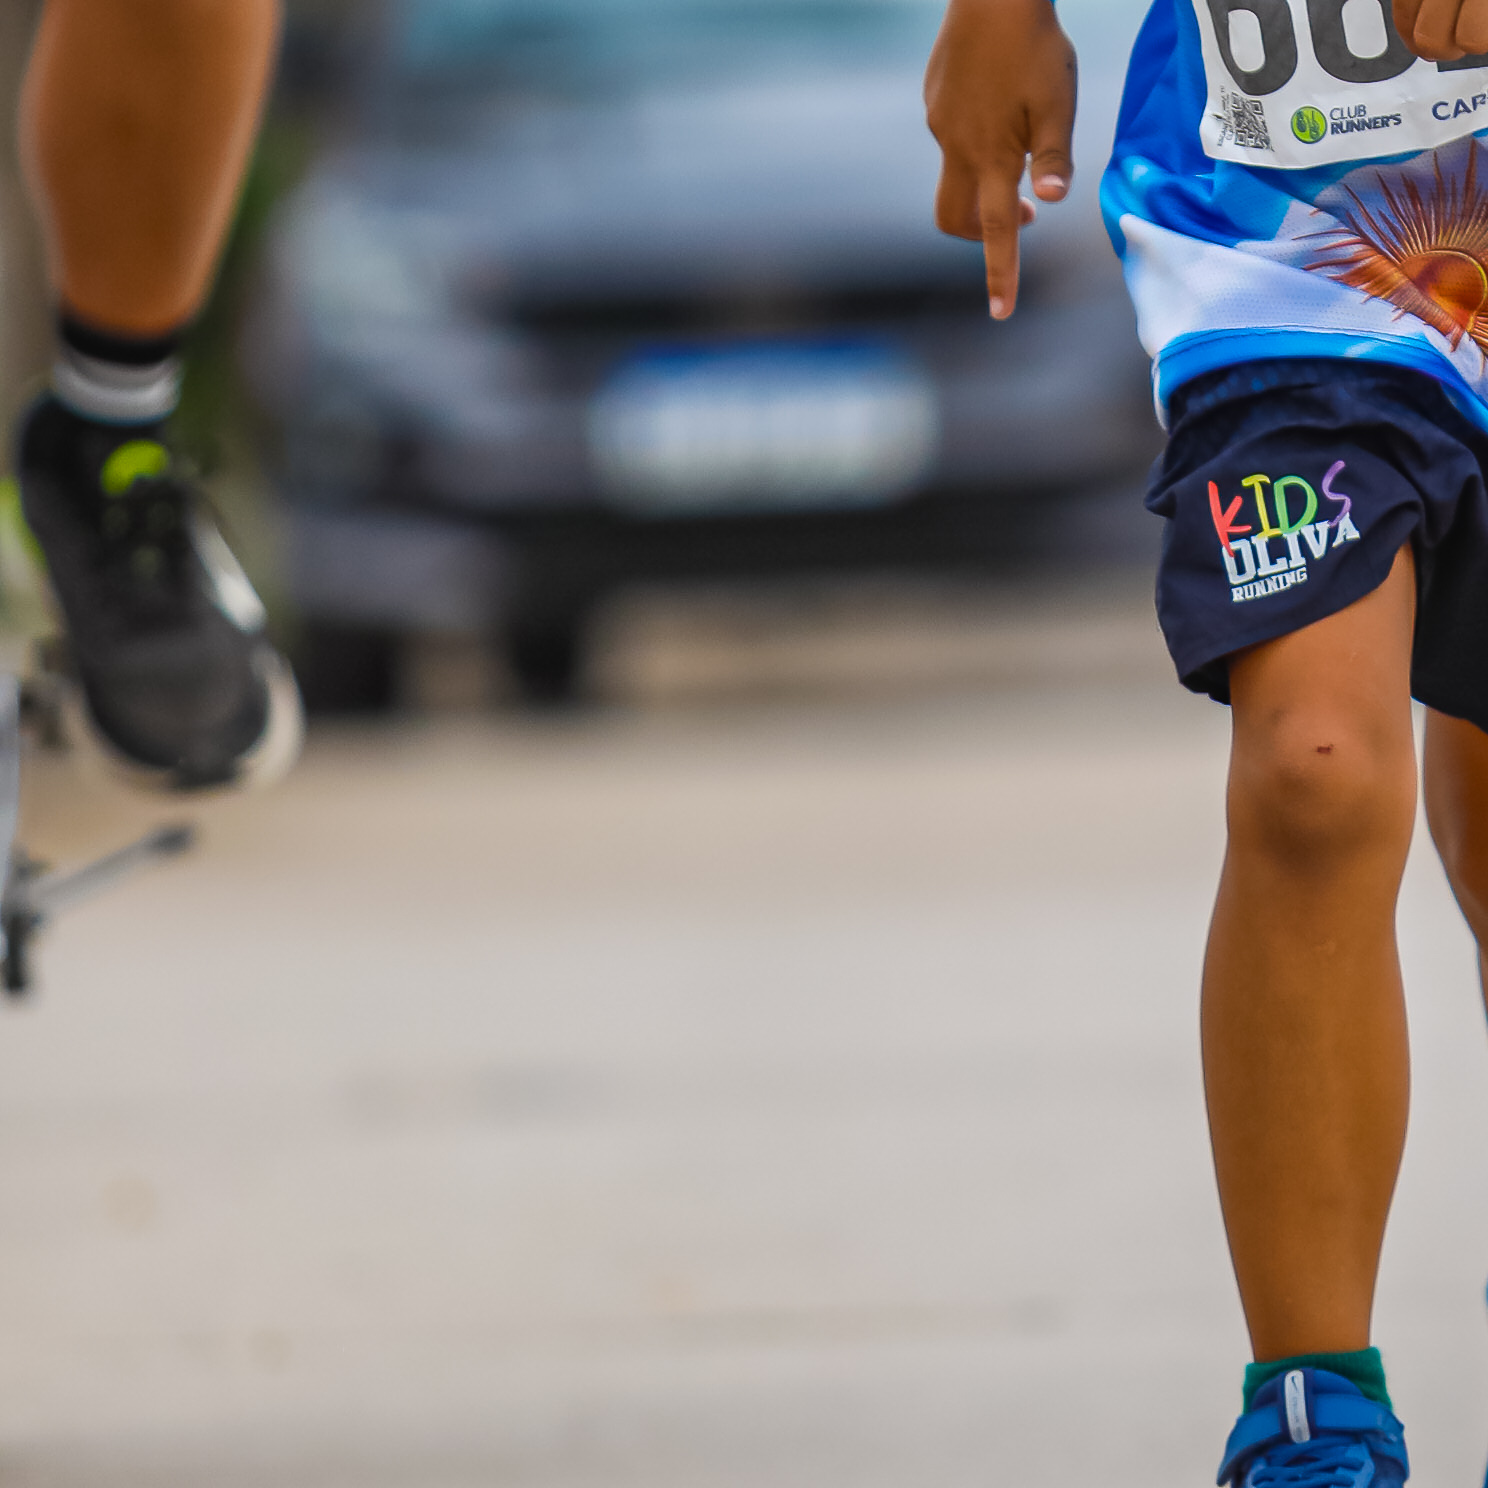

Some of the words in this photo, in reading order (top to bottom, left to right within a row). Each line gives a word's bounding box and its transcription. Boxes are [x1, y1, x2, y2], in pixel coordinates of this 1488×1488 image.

[1329, 104, 1367, 121] CLUB
[1207, 460, 1352, 558] KIDS
[1222, 512, 1361, 585] OLIVA
[1231, 566, 1308, 602] RUNNING
